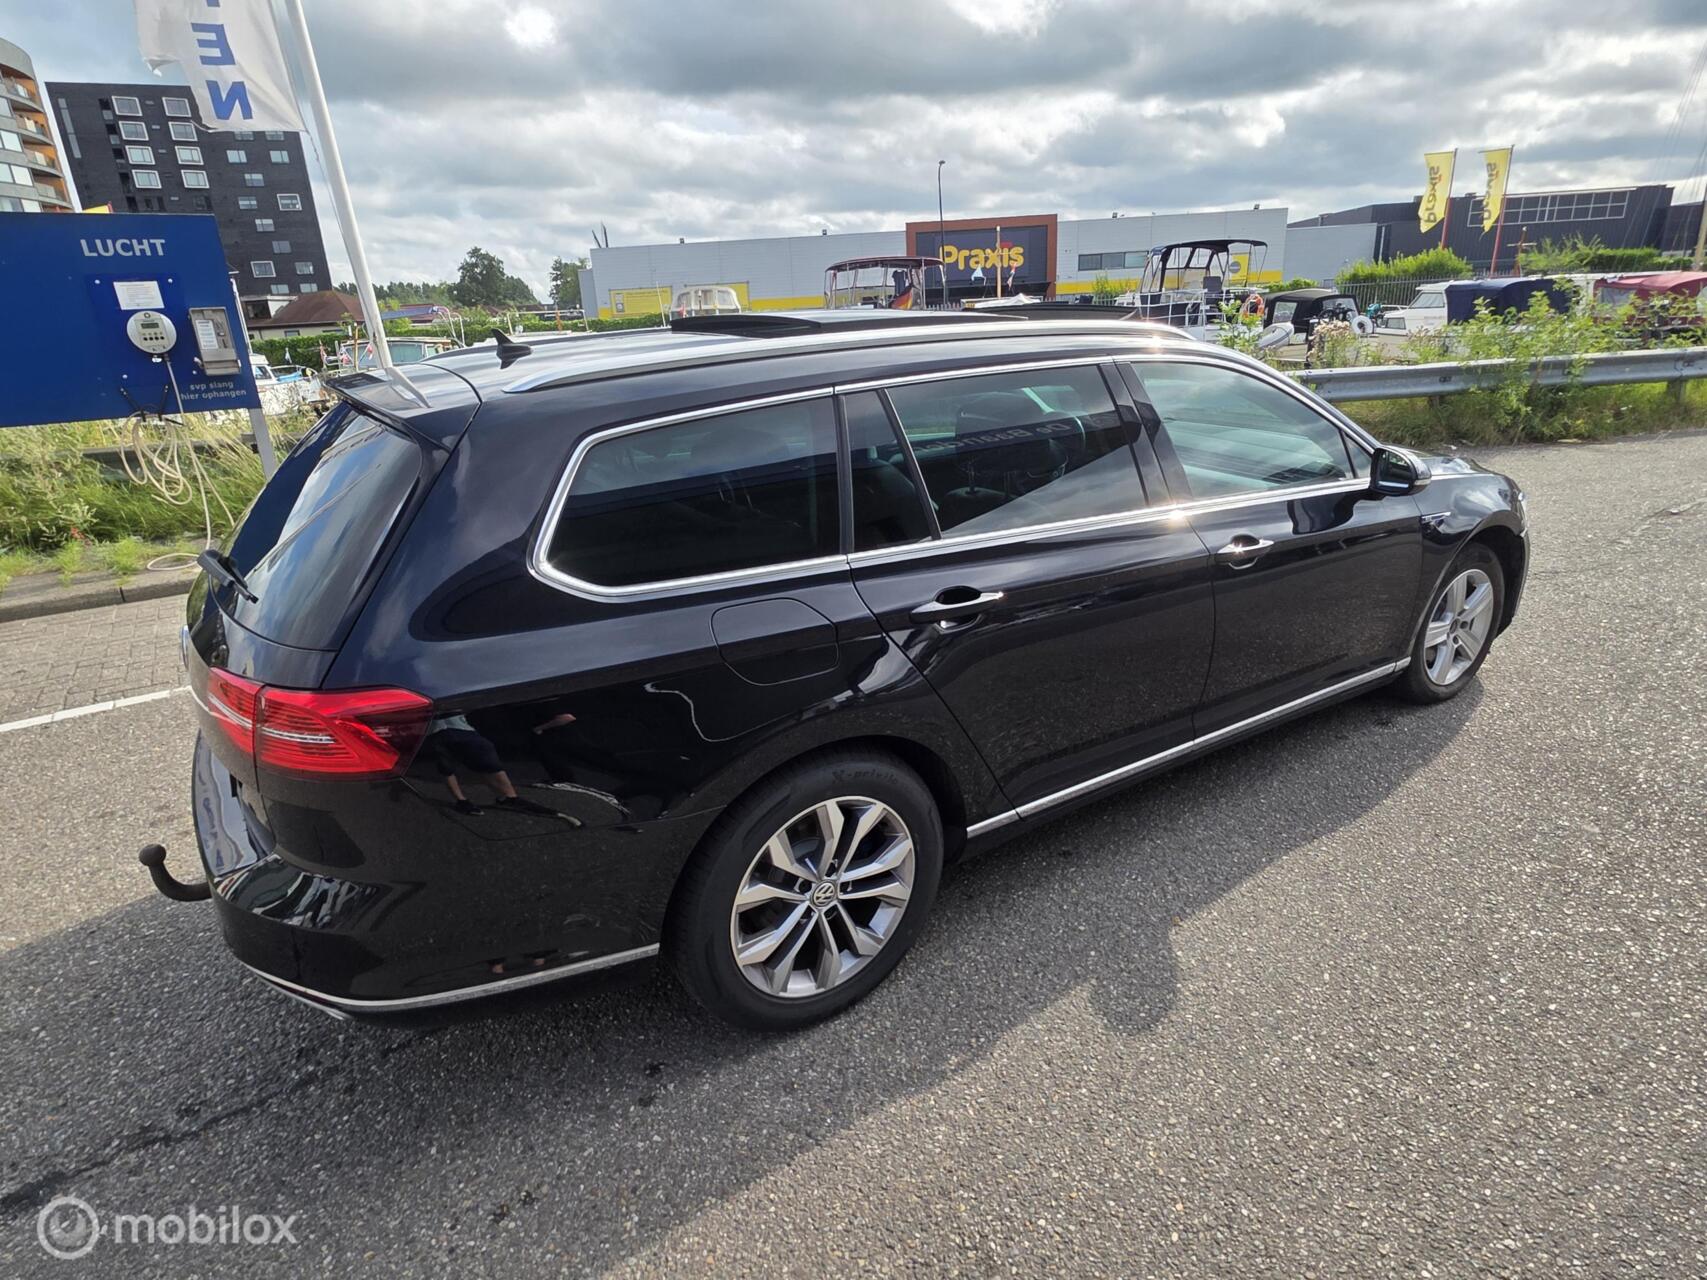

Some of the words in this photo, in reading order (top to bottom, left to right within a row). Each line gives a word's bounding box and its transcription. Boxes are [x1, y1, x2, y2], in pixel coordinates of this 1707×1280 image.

[80, 238, 166, 257] LUCHT
[939, 245, 1024, 271] Praxis
[189, 383, 207, 391] svp
[209, 381, 234, 389] slang
[180, 392, 199, 400] hier
[201, 389, 247, 399] ophangen
